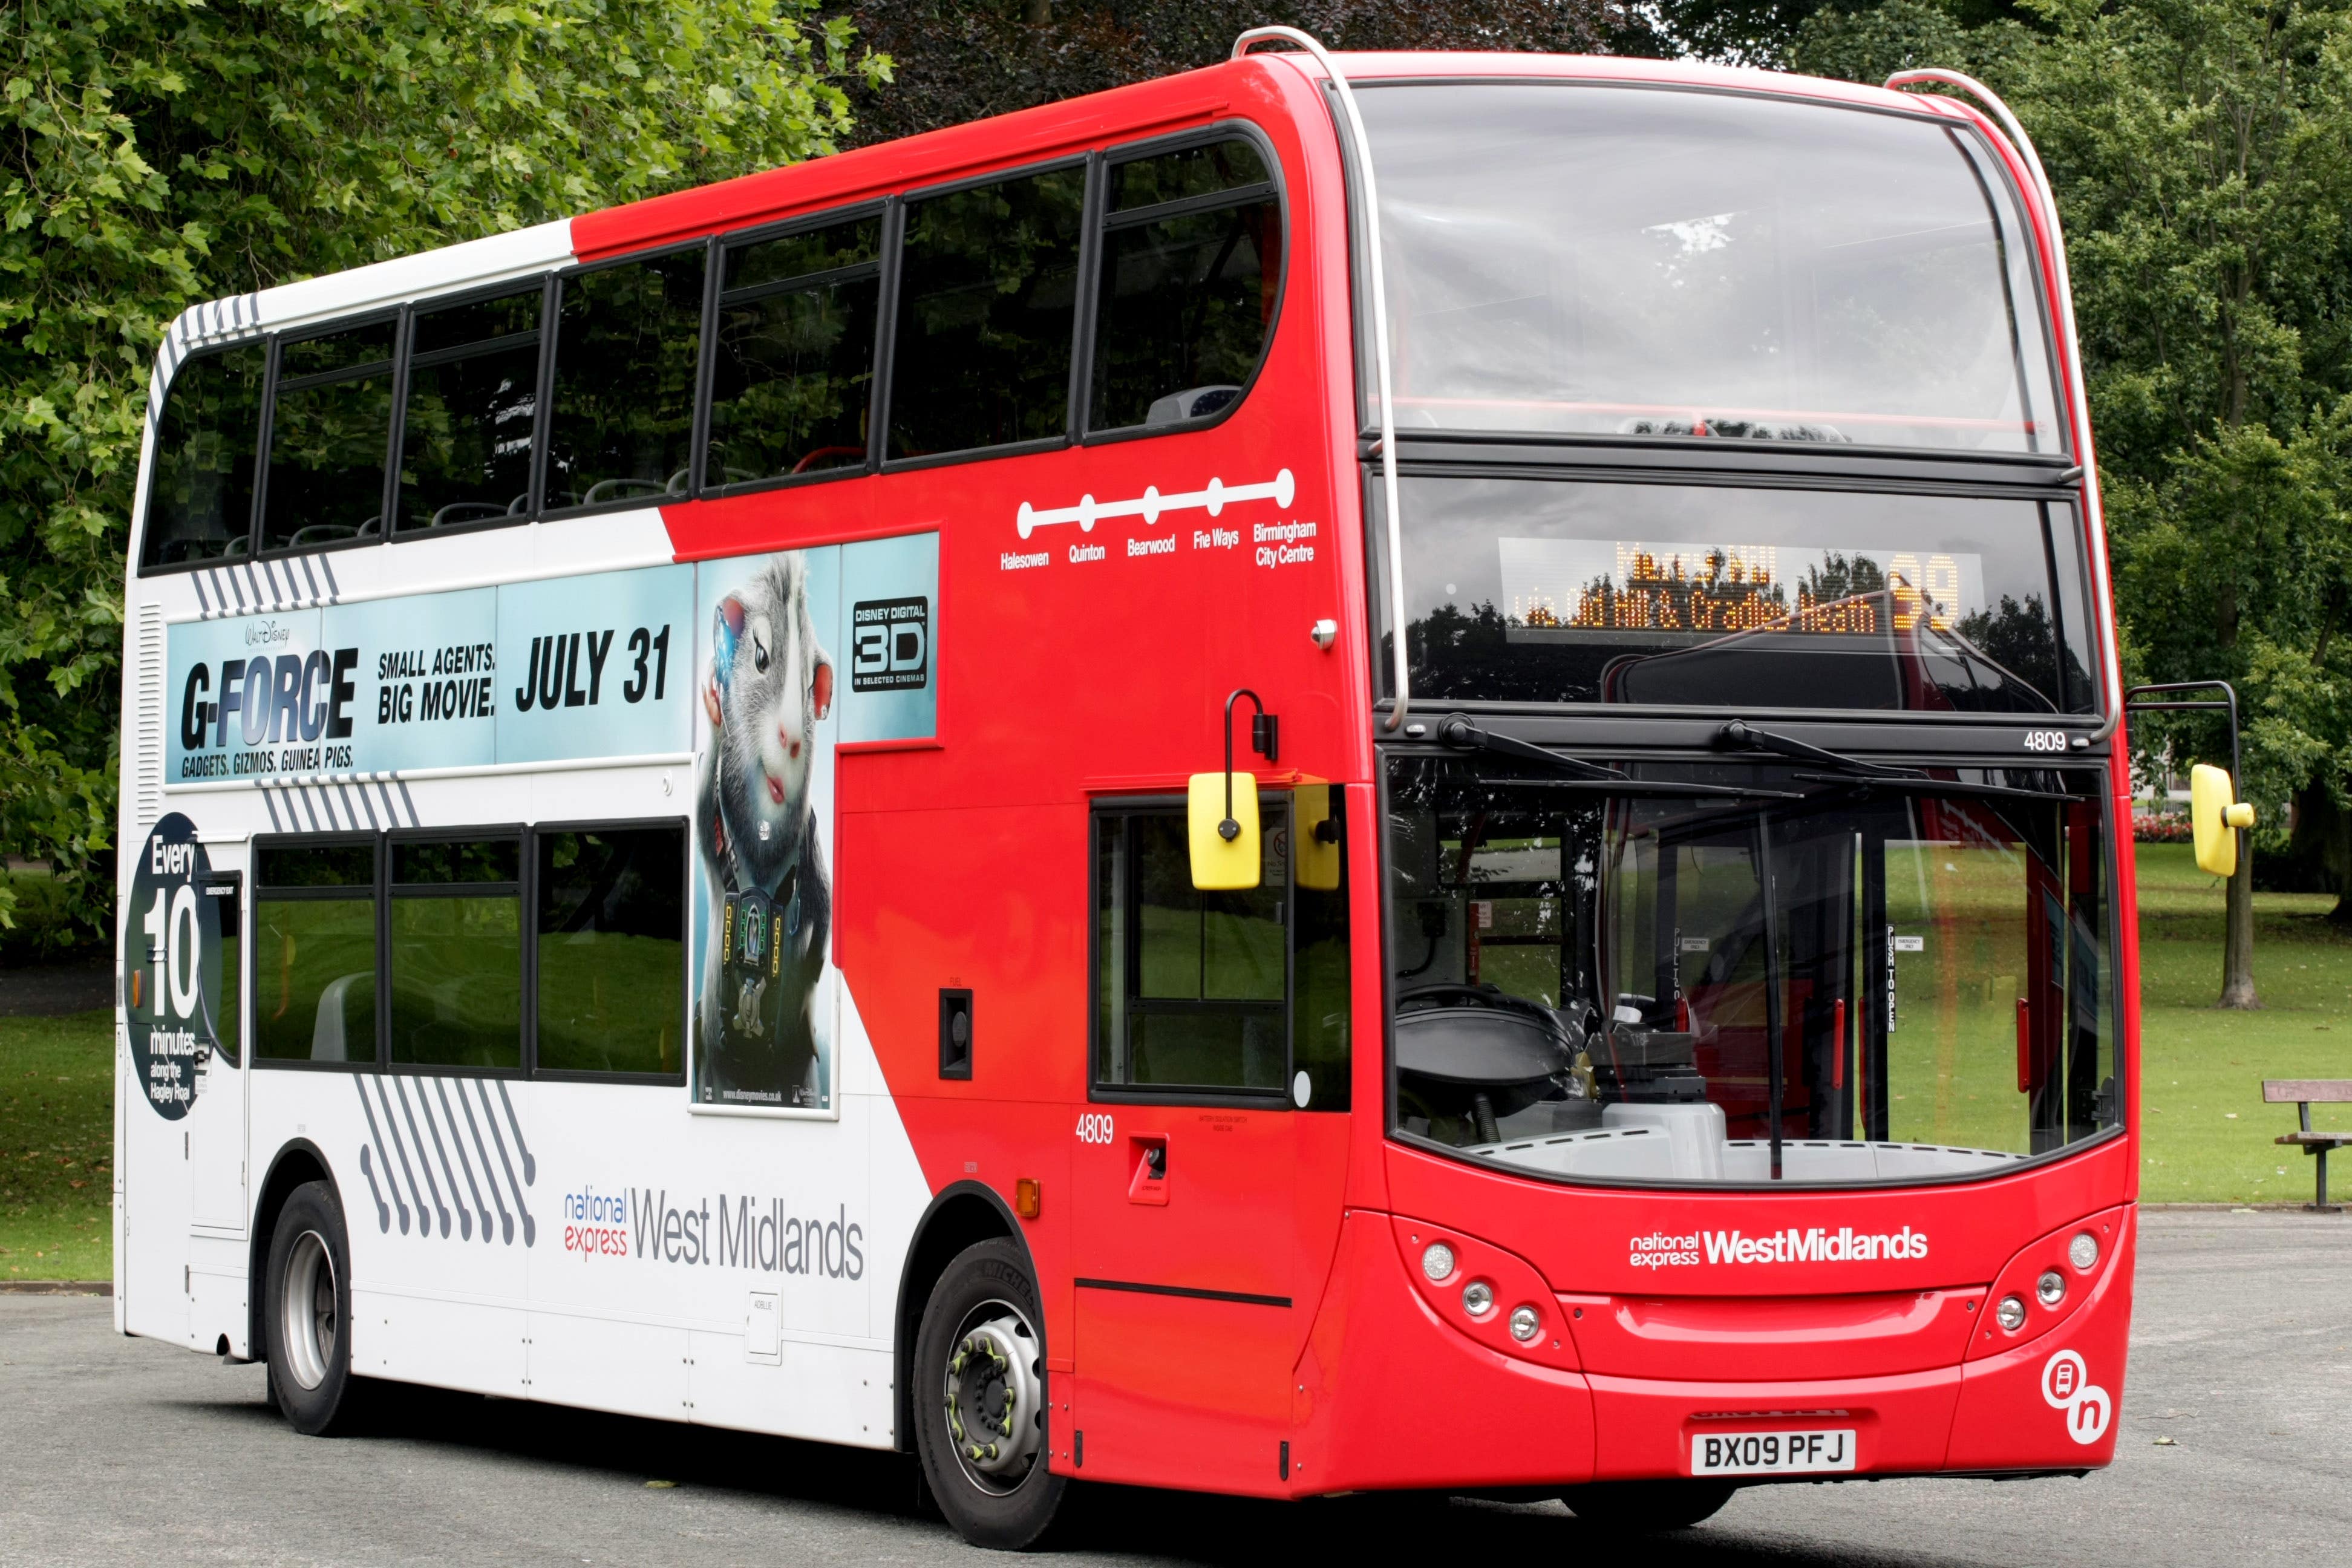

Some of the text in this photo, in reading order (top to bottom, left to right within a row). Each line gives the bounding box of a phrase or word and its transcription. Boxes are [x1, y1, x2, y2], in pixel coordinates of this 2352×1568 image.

[1127, 534, 1175, 557] Bearwood
[1194, 528, 1239, 549] Five Ways
[1253, 520, 1316, 543] Birmingham
[1001, 550, 1049, 570] Halesowen
[1069, 543, 1105, 563] Quinton
[1256, 544, 1315, 569] City Centre
[1889, 554, 1958, 630] 99
[855, 604, 925, 622] DISNEY DIGITAL
[1614, 589, 1649, 627] Hill
[1659, 590, 1680, 628] &
[1691, 590, 1791, 630] Cradley
[1801, 594, 1874, 633] Heath
[378, 643, 495, 680] SMALL AGENTS.
[855, 622, 925, 674] 3D
[516, 624, 670, 712] JULY 31
[863, 676, 894, 685] SELECTED
[896, 673, 924, 684] CINEMAS
[181, 647, 359, 750] G-FORCE
[378, 677, 495, 724] BIG MOVIE.
[2024, 731, 2066, 751] 4809
[181, 745, 353, 778] GADGETS. GIZMOS. GUINEA PIGS.
[152, 835, 195, 882] Every
[145, 885, 199, 1018] 10
[1887, 969, 1895, 990] TO
[151, 1025, 195, 1056] minutes
[151, 1060, 181, 1082] along the
[151, 1082, 174, 1103] Hagley
[723, 1089, 782, 1102] www.disneymovies.co.uk
[1076, 1113, 1114, 1144] 4809
[564, 1184, 627, 1223] national
[564, 1225, 627, 1263] express
[632, 1187, 864, 1281] West Midlands
[1630, 1231, 1699, 1250] national
[1630, 1252, 1699, 1270] express
[1705, 1434, 1843, 1467] BX09 PFJ
